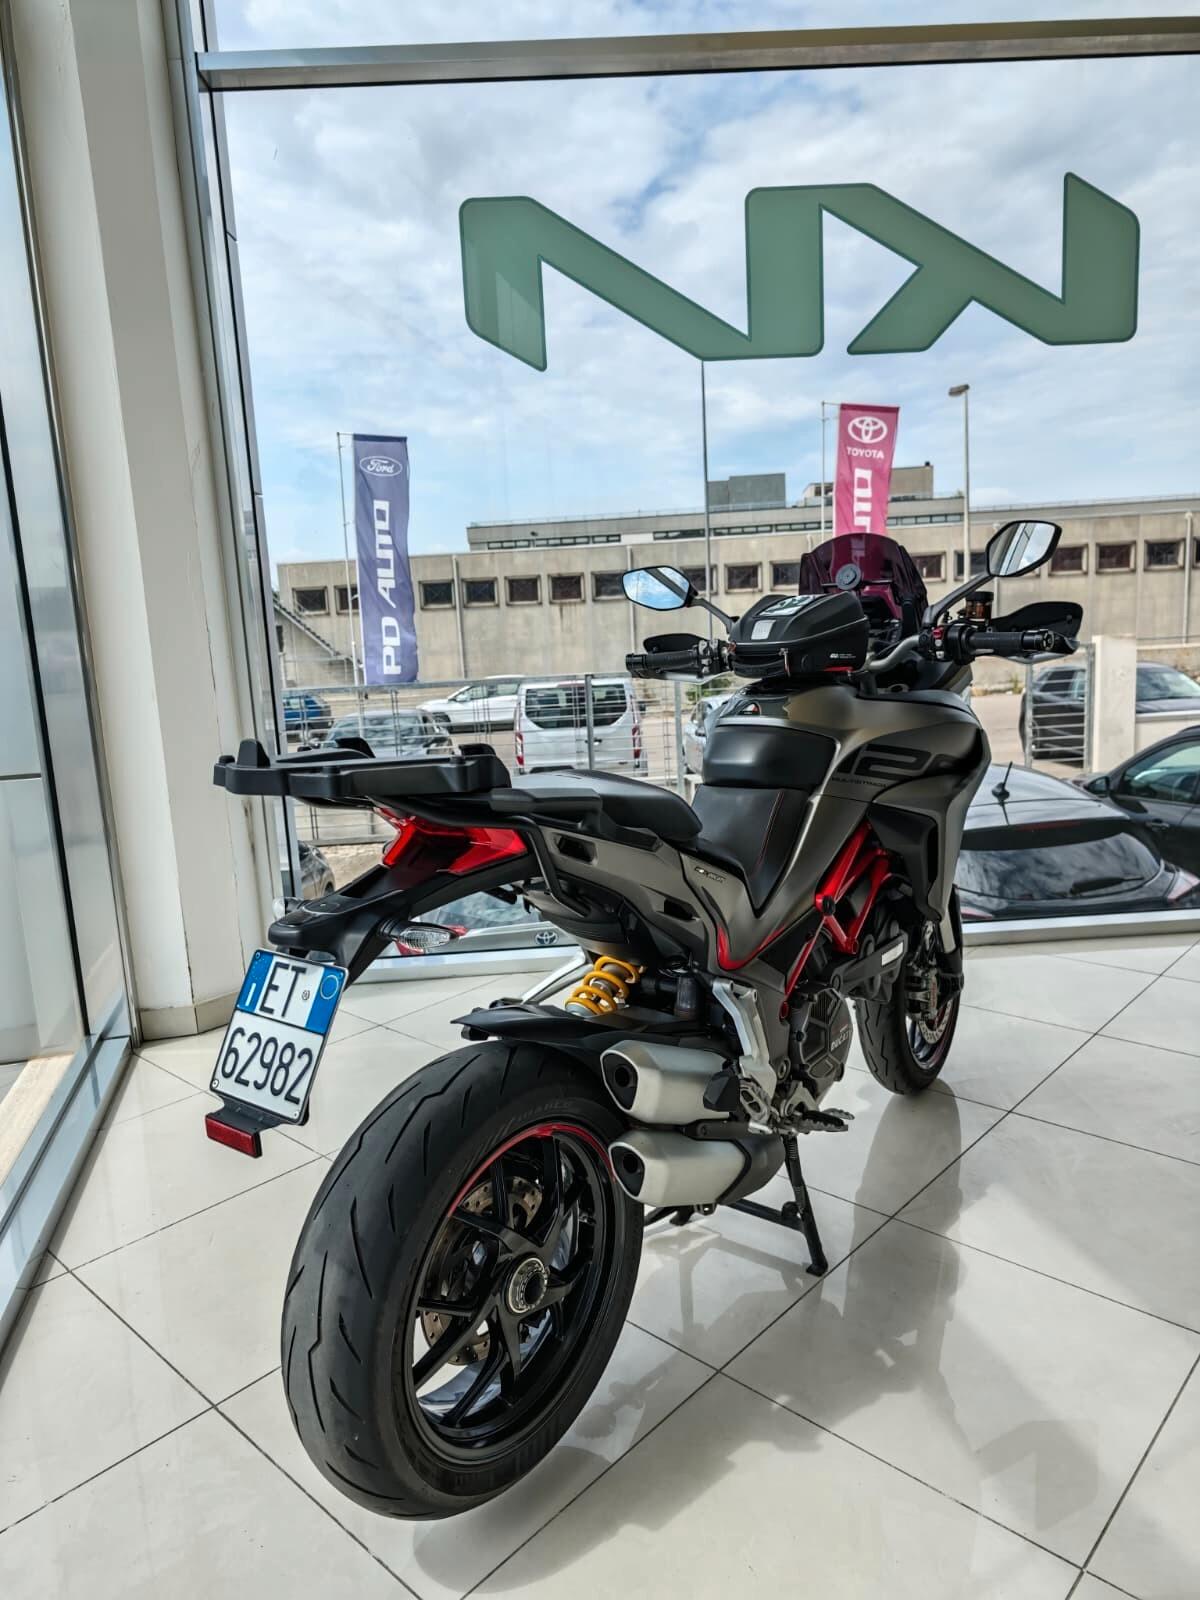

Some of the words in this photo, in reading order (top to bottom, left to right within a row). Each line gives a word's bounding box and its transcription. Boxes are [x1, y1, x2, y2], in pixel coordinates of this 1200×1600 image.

[366, 458, 396, 475] Ford
[846, 446, 885, 460] TOYOTA
[373, 499, 397, 609] AUTO
[381, 616, 402, 676] PD
[244, 982, 257, 1007] I
[258, 961, 308, 1019] ET
[221, 1027, 314, 1106] 62982
